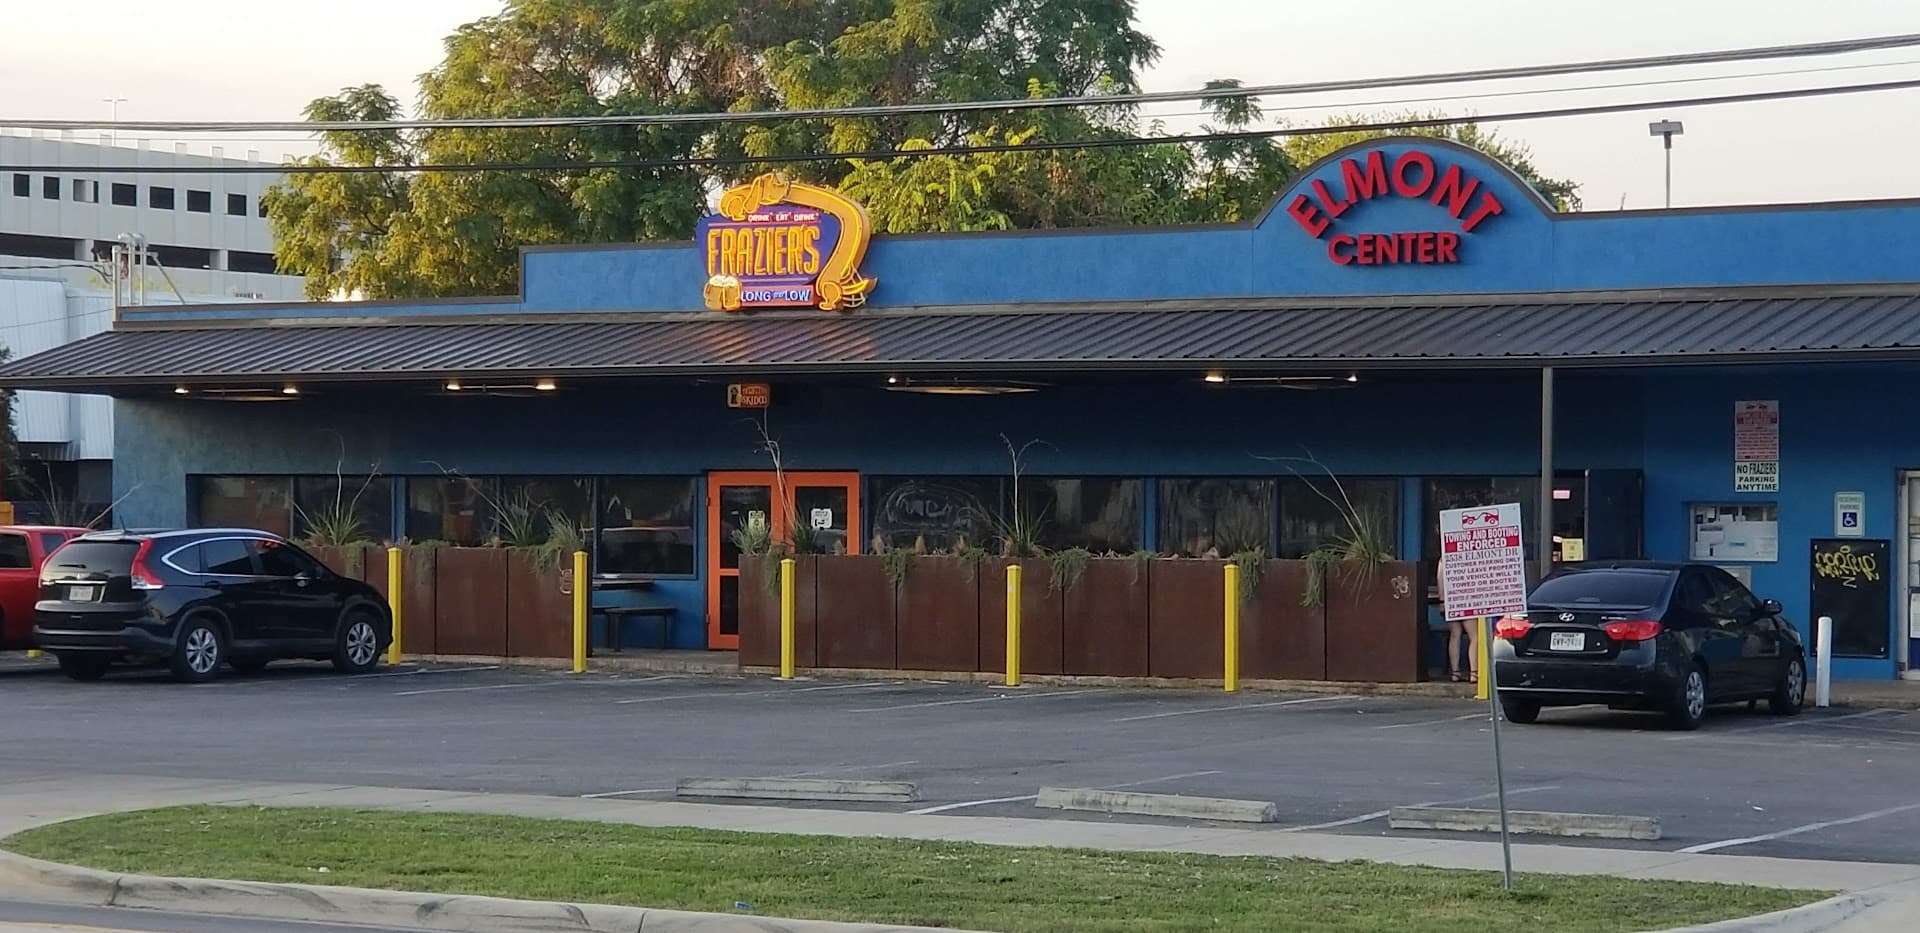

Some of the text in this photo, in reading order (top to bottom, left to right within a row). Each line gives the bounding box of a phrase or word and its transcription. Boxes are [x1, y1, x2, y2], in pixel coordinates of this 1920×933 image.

[1287, 150, 1504, 238] ELMONT
[707, 224, 820, 275] FRAZIER'S
[1327, 231, 1459, 266] CENTER
[741, 291, 771, 301] LONG
[784, 289, 811, 301] LOW
[1737, 464, 1748, 474] NO
[1736, 483, 1776, 491] ANYTIME
[1445, 526, 1517, 542] TOWING AND BOOTING
[1457, 537, 1506, 551] ENFORCED
[1465, 548, 1501, 560] ELMONT
[1505, 547, 1517, 556] DR
[1488, 563, 1520, 571] PROPERTY
[1489, 576, 1516, 584] BOOTED
